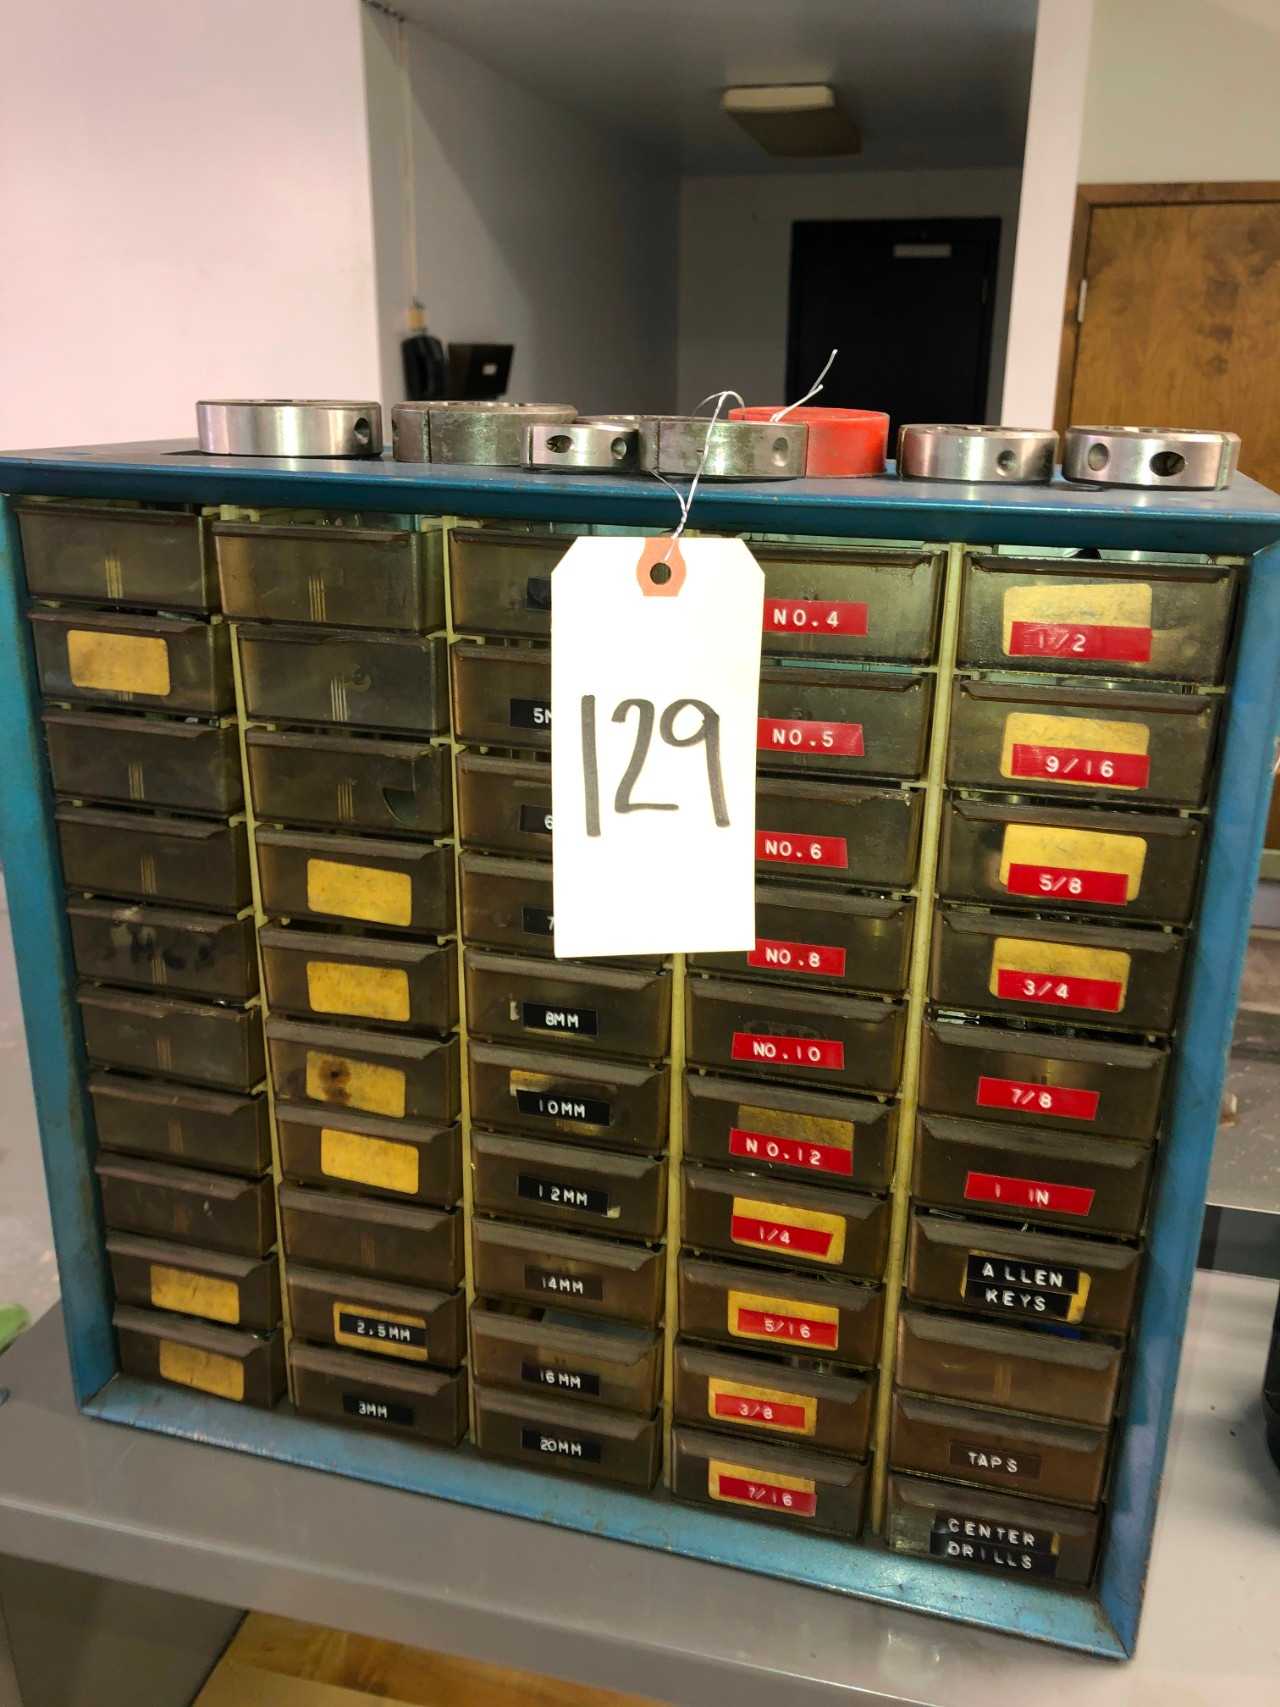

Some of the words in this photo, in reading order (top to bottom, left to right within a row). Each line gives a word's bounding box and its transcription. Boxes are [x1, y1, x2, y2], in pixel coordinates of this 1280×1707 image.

[774, 608, 839, 628] NO.4
[772, 727, 834, 748] NO.5
[581, 693, 731, 838] 129
[1045, 755, 1115, 778] 9/16
[764, 838, 823, 860] NO.6
[1038, 873, 1082, 896] 5/8
[765, 947, 821, 969] NO.8
[1022, 978, 1069, 1000] 3/4
[545, 1010, 580, 1030] 8MM
[752, 1040, 822, 1061] NO.10
[1009, 1087, 1054, 1110] 7/8
[538, 1100, 587, 1120] 10MM
[538, 1185, 589, 1208] 12MM
[993, 1181, 1002, 1200] 1
[1027, 1186, 1050, 1207] IN
[758, 1225, 791, 1246] 1/4
[541, 1276, 585, 1297] 14MM
[981, 1262, 1064, 1289] ALLEN
[985, 1287, 1047, 1312] KEYS
[355, 1321, 412, 1343] 2.5MM
[763, 1319, 812, 1340] 5/16
[538, 1369, 583, 1391] 16MM
[357, 1400, 389, 1420] 3MM
[738, 1403, 774, 1421] 3/8
[539, 1438, 583, 1458] 20MM
[967, 1451, 1019, 1473] TAPS
[746, 1485, 794, 1508] 7/16
[945, 1515, 1037, 1548] CENTER
[946, 1539, 1034, 1571] DRILLS
